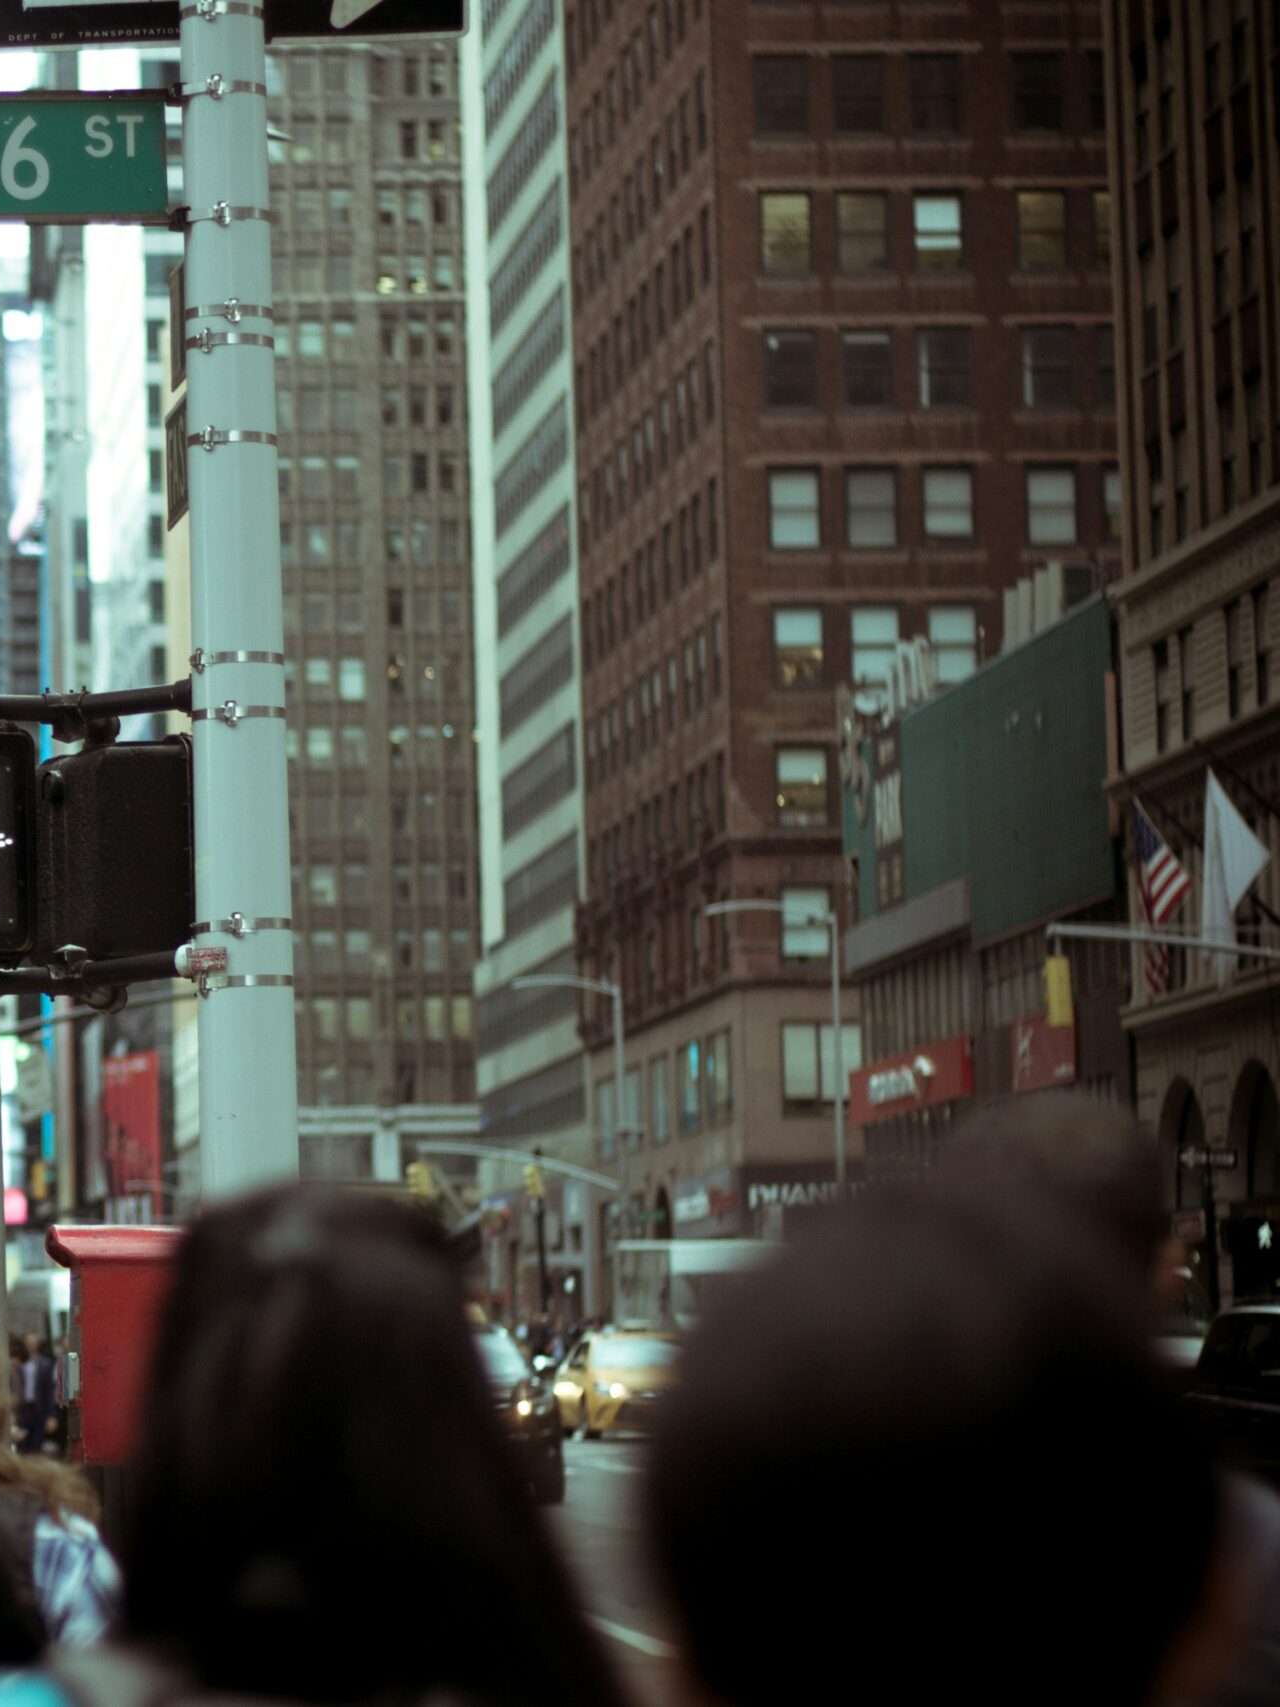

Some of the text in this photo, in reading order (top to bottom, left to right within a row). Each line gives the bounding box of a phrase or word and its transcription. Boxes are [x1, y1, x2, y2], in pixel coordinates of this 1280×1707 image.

[8, 33, 37, 42] DEPT
[51, 32, 65, 40] OF
[84, 115, 144, 159] ST
